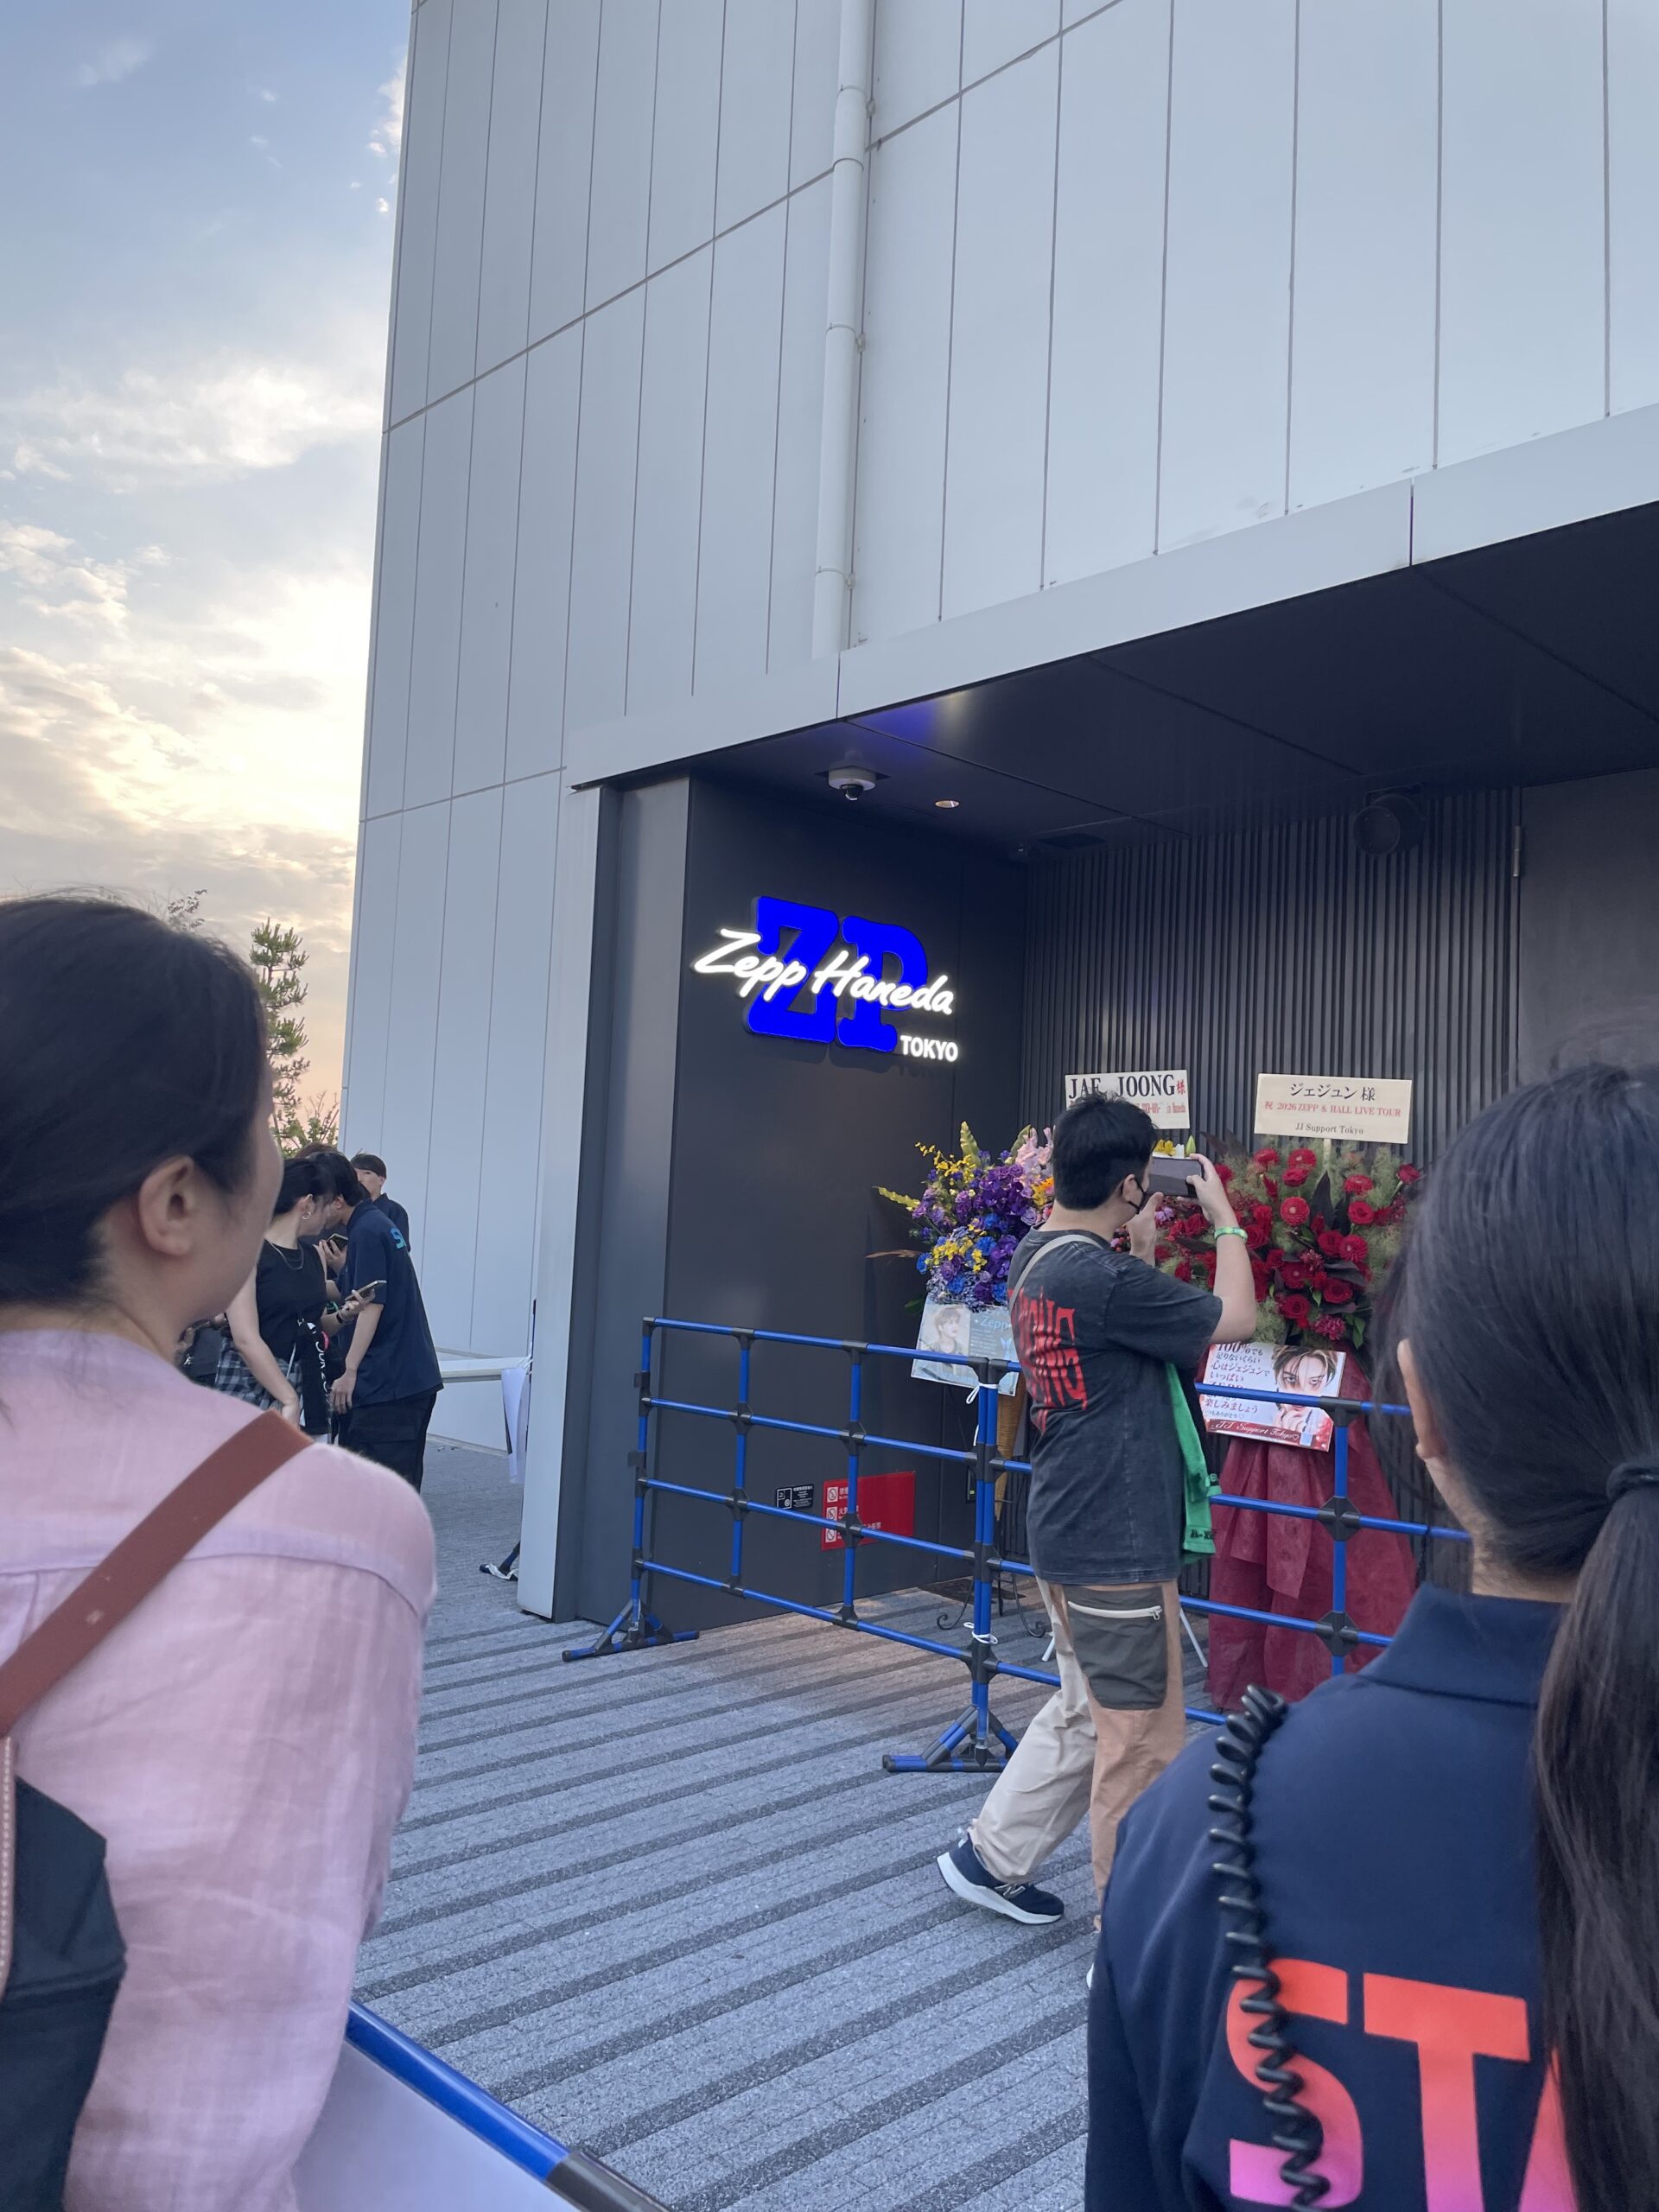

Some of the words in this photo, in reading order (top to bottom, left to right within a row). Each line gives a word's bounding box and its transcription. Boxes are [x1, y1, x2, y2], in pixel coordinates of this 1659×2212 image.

[694, 927, 807, 1002] Zepp
[810, 950, 954, 1015] Haneda
[899, 1035, 959, 1062] TOKYO
[1116, 1074, 1175, 1097] JOONG
[1290, 1082, 1358, 1100] ジェジュン
[1361, 1086, 1376, 1102] 様
[1276, 1102, 1297, 1111] 2026
[1298, 1103, 1319, 1112] ZEPP
[1330, 1105, 1352, 1114] HALL
[1354, 1106, 1376, 1116] LIVE
[1377, 1107, 1402, 1117] TOUR
[1295, 1122, 1304, 1131] JJ
[1306, 1123, 1337, 1134] Support
[1339, 1125, 1363, 1135] Tokyo
[980, 1315, 1008, 1332] Zepp
[1236, 1422, 1269, 1434] Support
